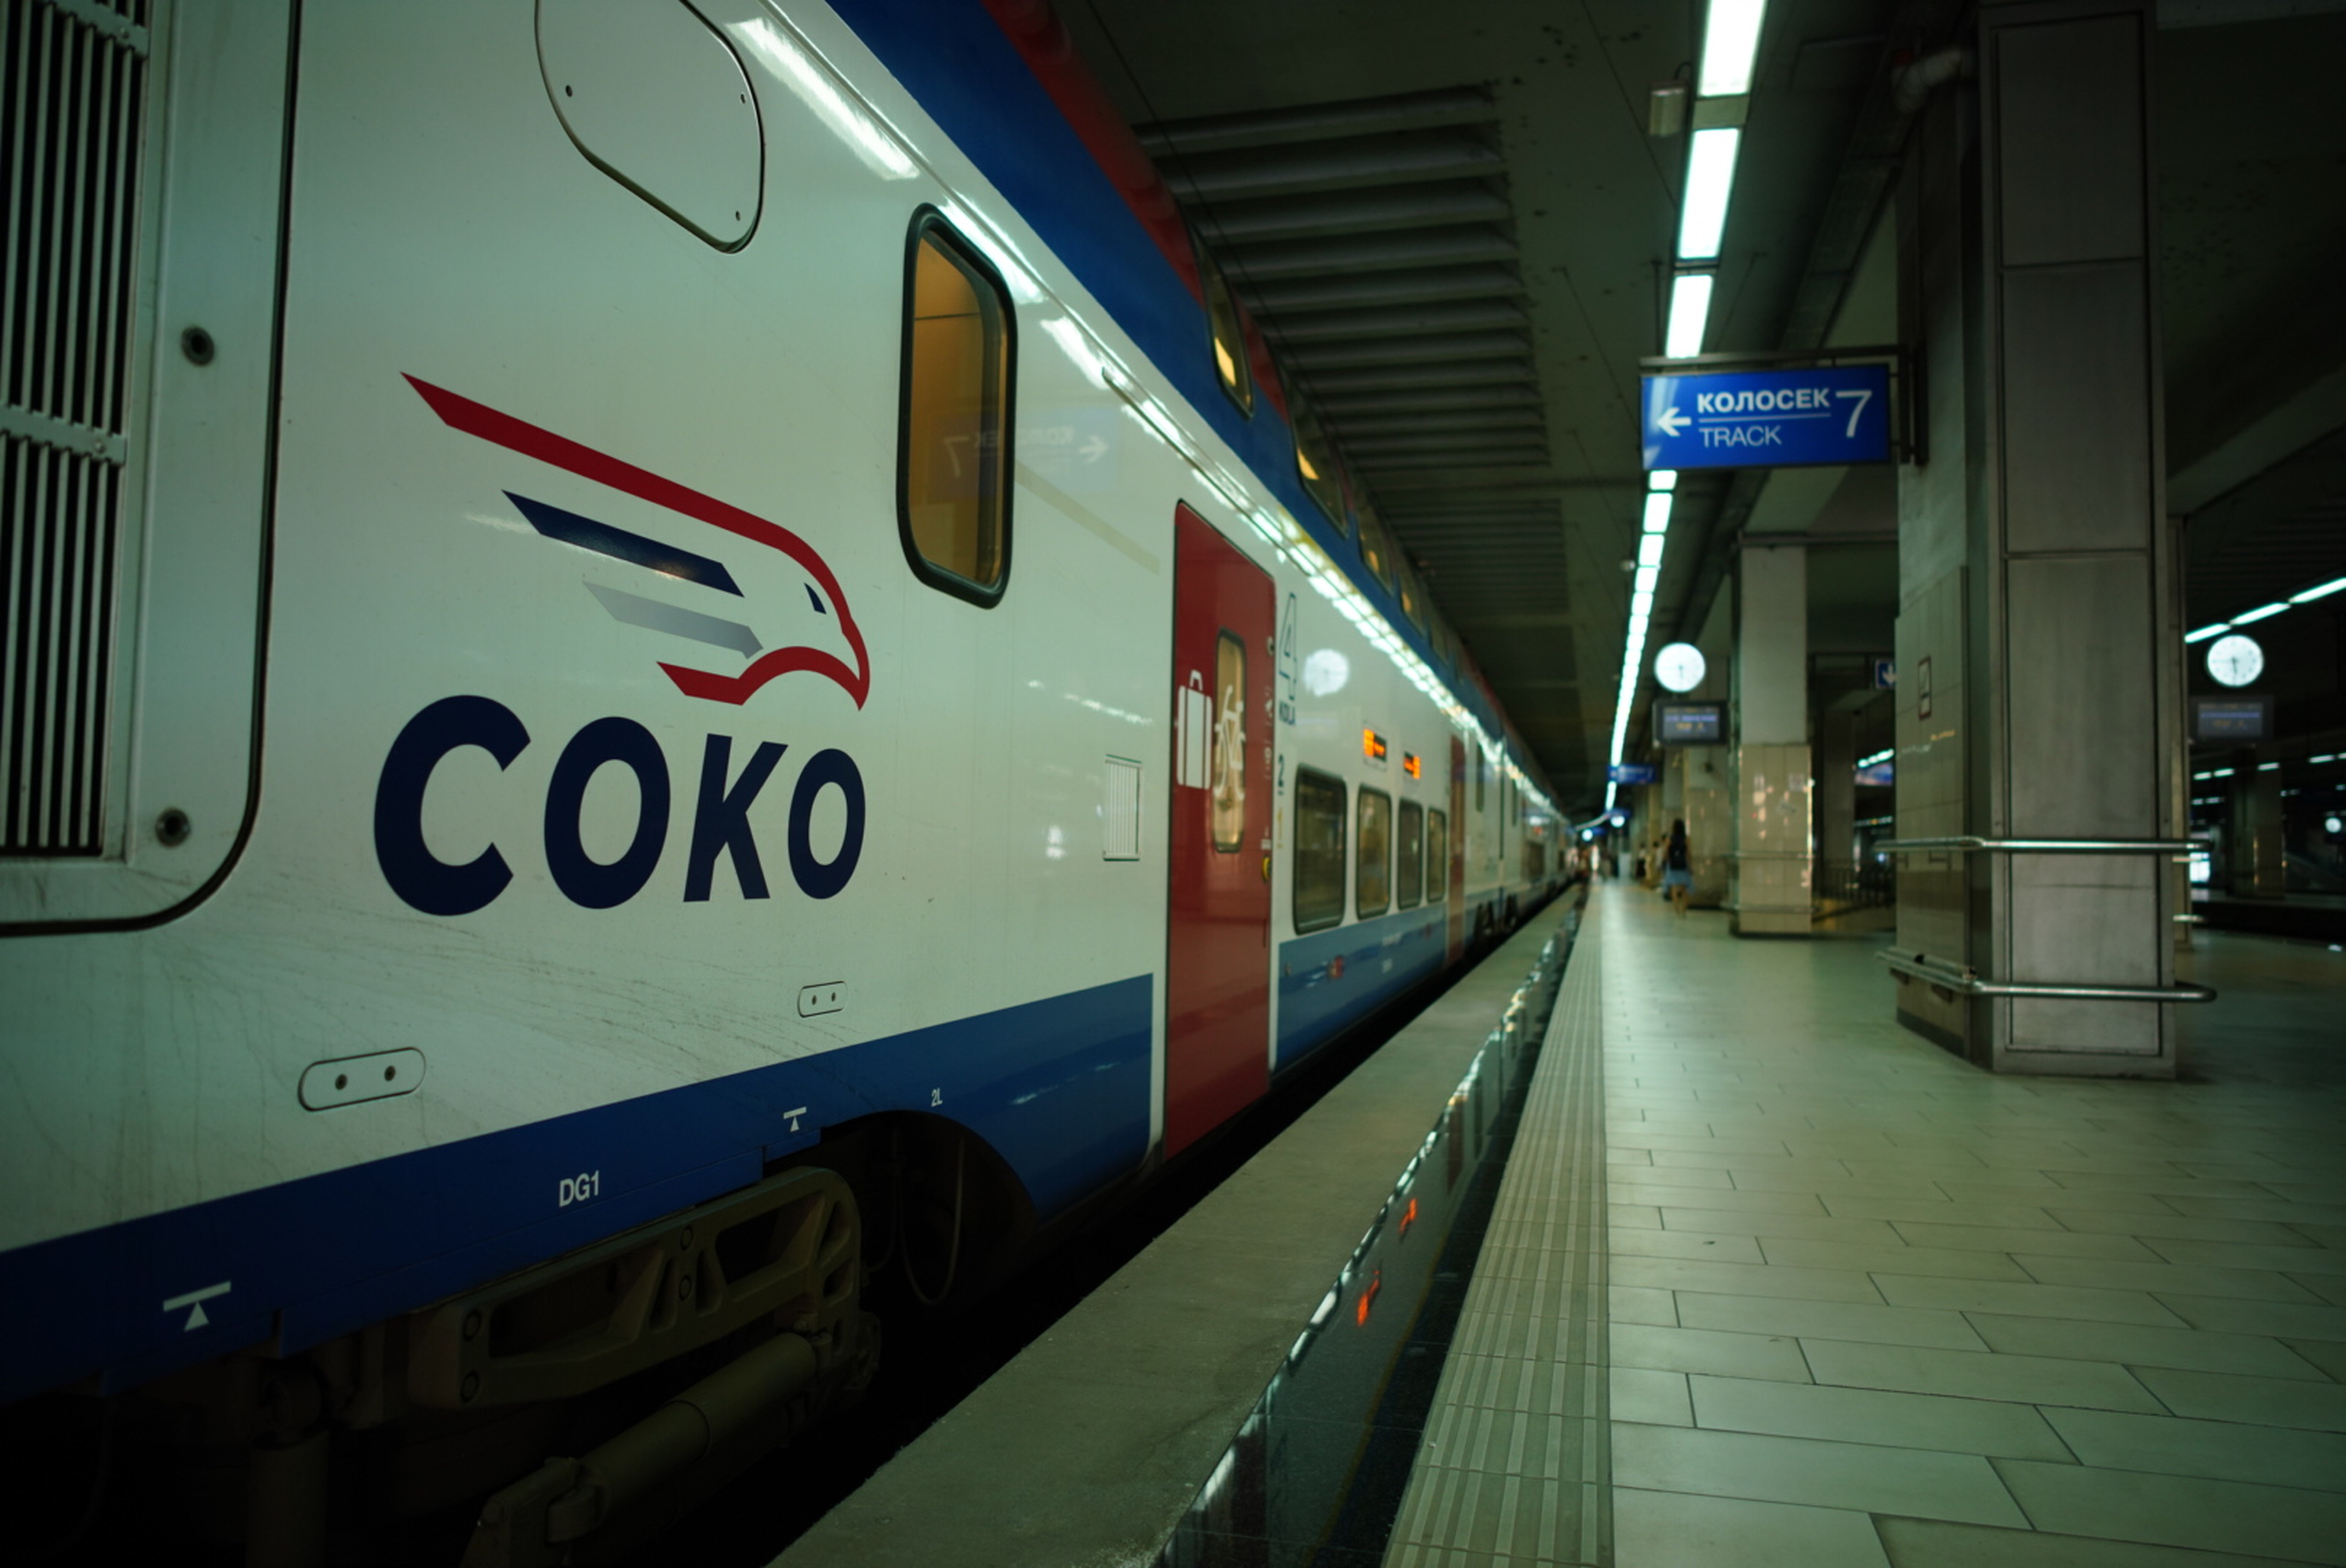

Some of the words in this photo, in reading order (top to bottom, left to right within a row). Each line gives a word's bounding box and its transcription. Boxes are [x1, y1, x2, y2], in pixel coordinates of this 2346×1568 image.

[1697, 388, 1831, 413] КОЛОСЕК
[1836, 390, 1872, 438] 7
[1699, 426, 1782, 448] TRACK
[373, 694, 866, 917] СОКО
[931, 1087, 943, 1107] 2L
[559, 1170, 600, 1208] DG1
